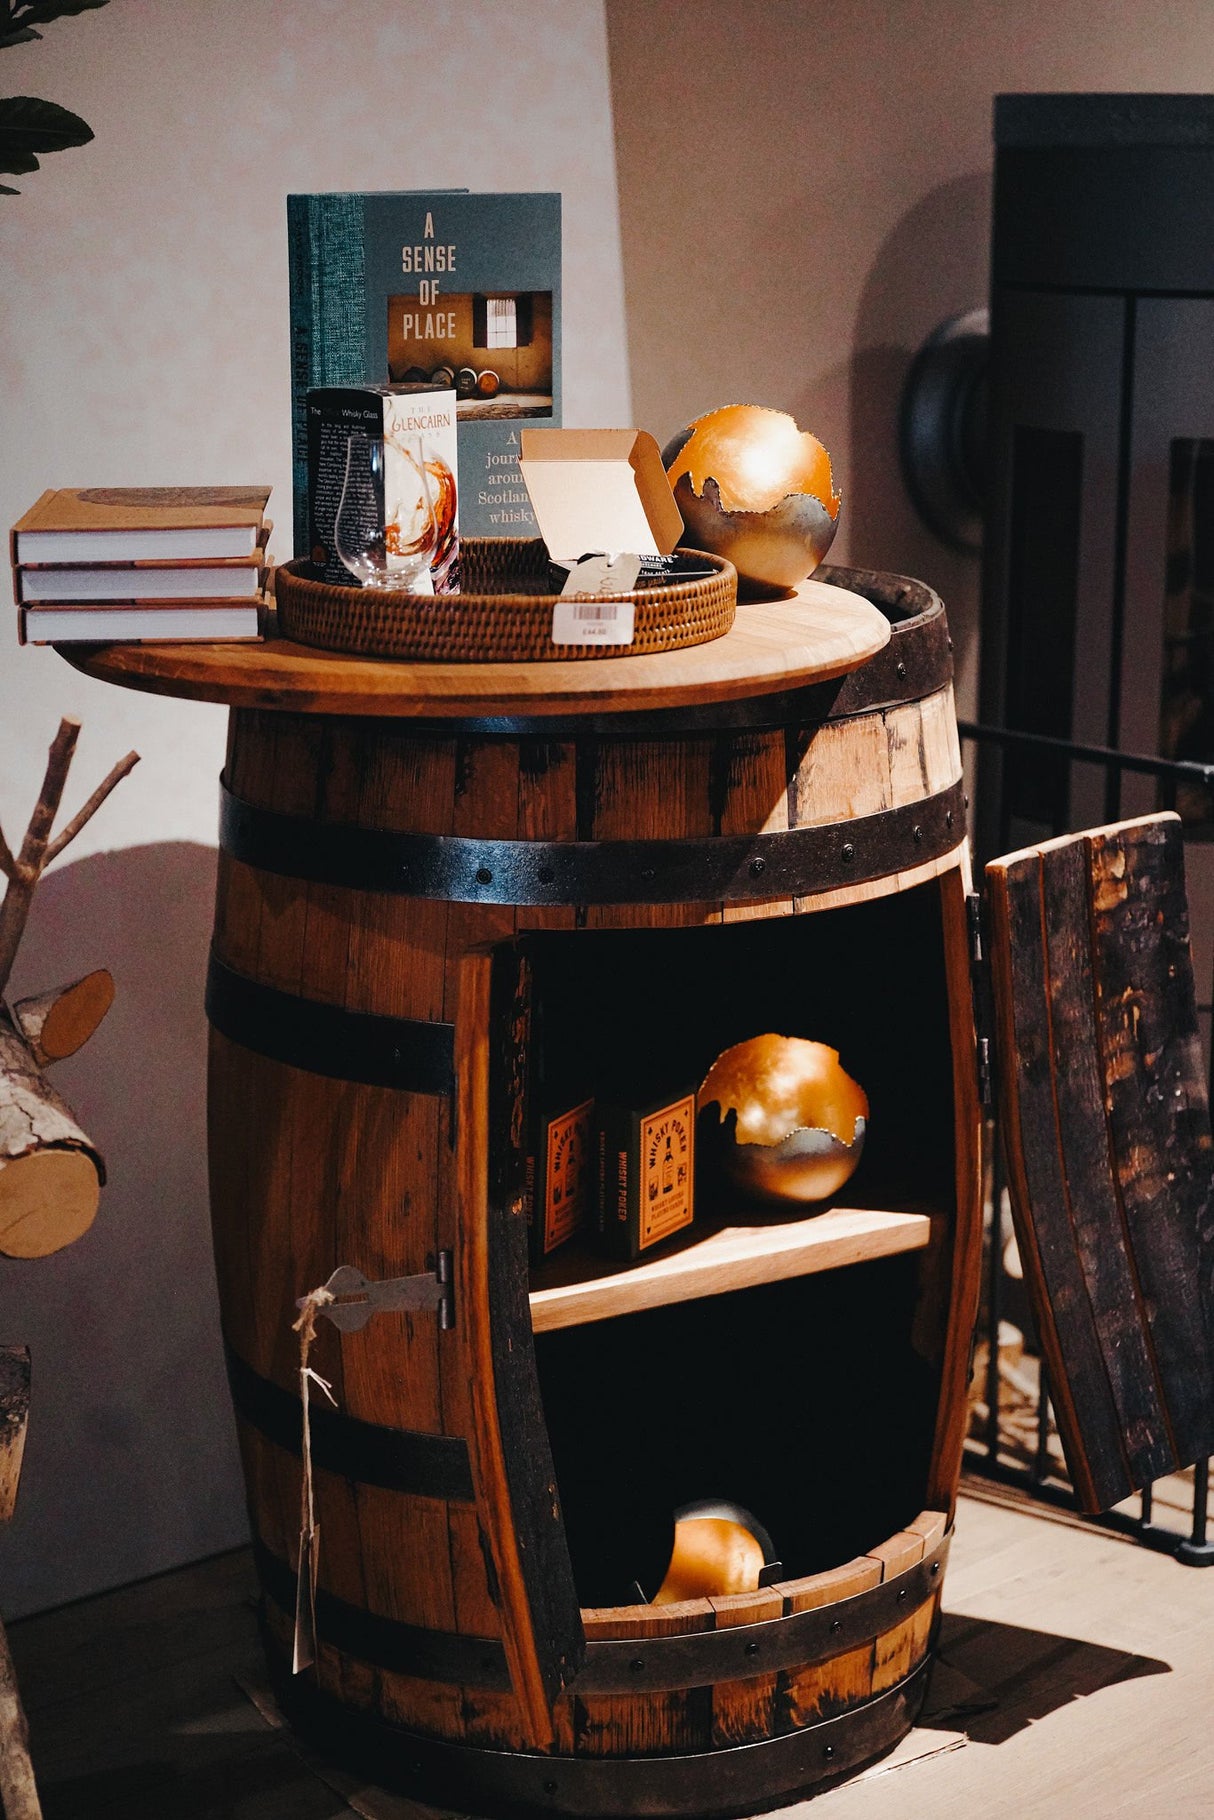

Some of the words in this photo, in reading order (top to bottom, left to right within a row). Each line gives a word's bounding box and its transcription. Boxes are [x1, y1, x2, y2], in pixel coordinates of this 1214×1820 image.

[424, 212, 434, 239] A
[402, 246, 456, 272] SENSE
[419, 279, 440, 306] OF
[403, 312, 456, 340] PLACE
[295, 342, 309, 388] SENSE
[310, 406, 322, 416] The
[341, 409, 362, 420] Whisky
[363, 409, 378, 419] Glass
[391, 412, 451, 433] GLENCAIRN
[506, 431, 518, 445] A
[648, 1122, 670, 1169] WHISKY
[671, 1119, 687, 1152] POKER
[617, 1151, 628, 1188] WHISKY
[617, 1188, 628, 1223] POKER
